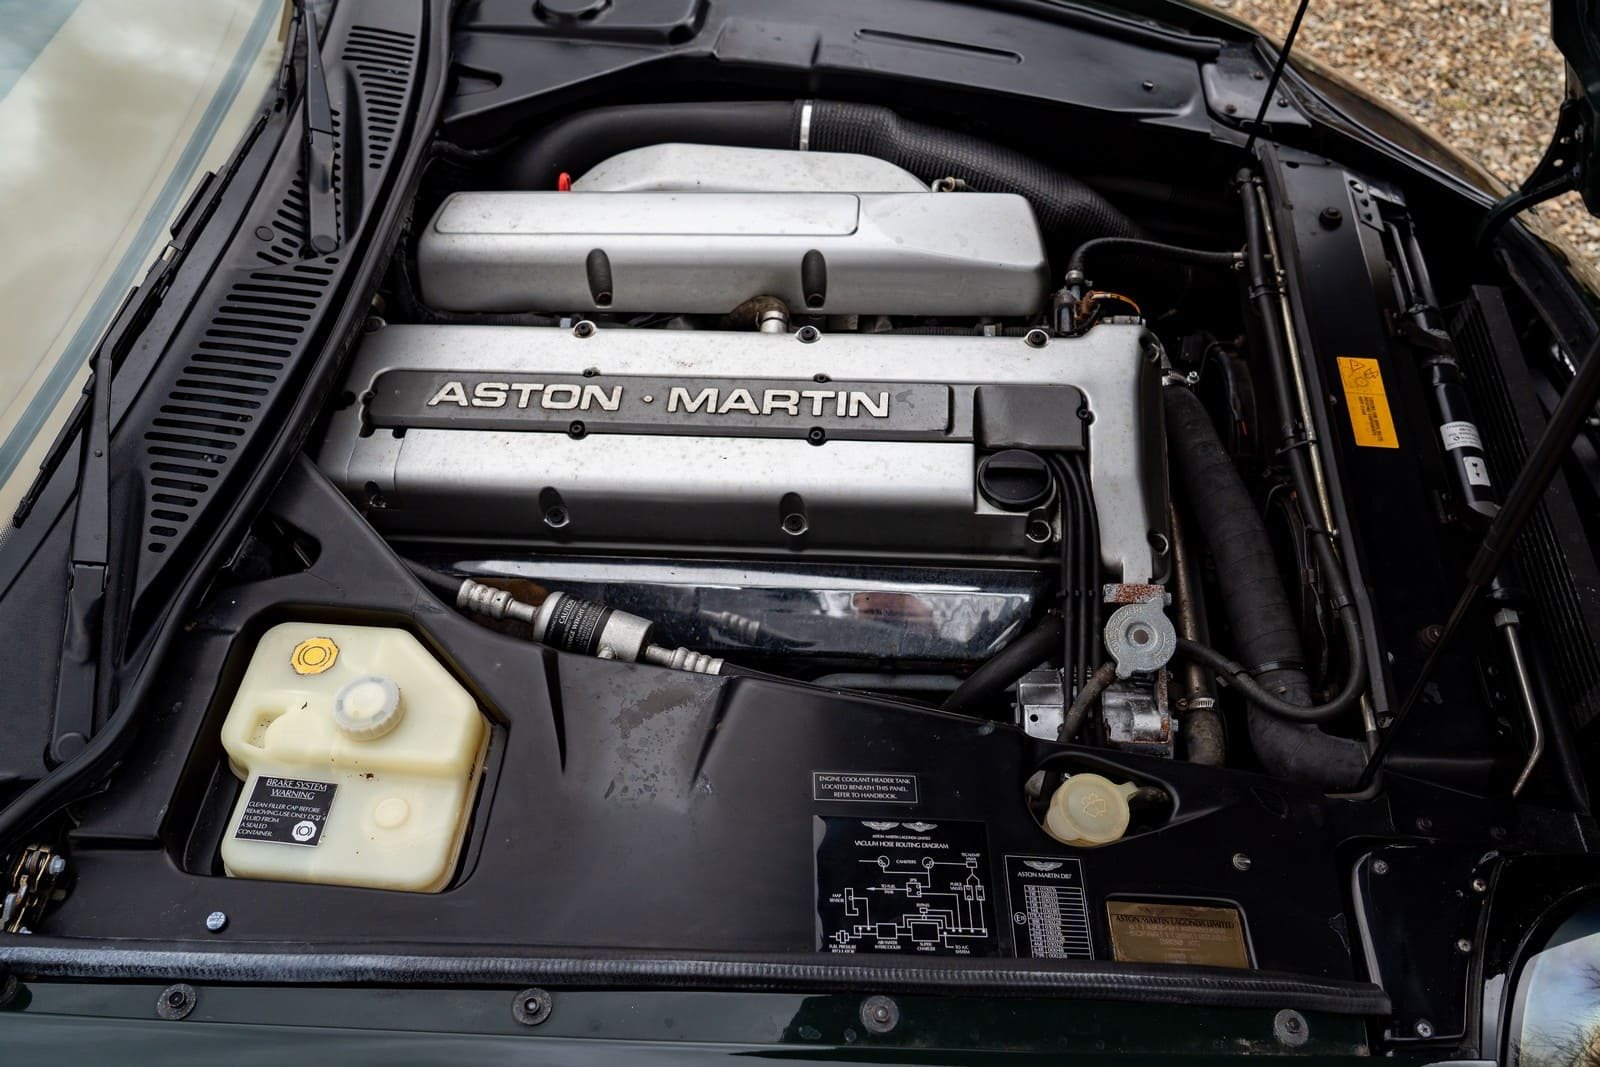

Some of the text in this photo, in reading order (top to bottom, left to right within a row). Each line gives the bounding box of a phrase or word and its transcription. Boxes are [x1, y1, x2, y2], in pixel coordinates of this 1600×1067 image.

[427, 382, 890, 418] ASTON MARTIN
[558, 600, 576, 624] CAUTION
[266, 778, 327, 792] BRAKE SYSTEM
[271, 788, 316, 800] WARNING
[248, 800, 267, 808] CLEAN
[268, 802, 286, 810] FILLER
[299, 805, 321, 813] BEFORE
